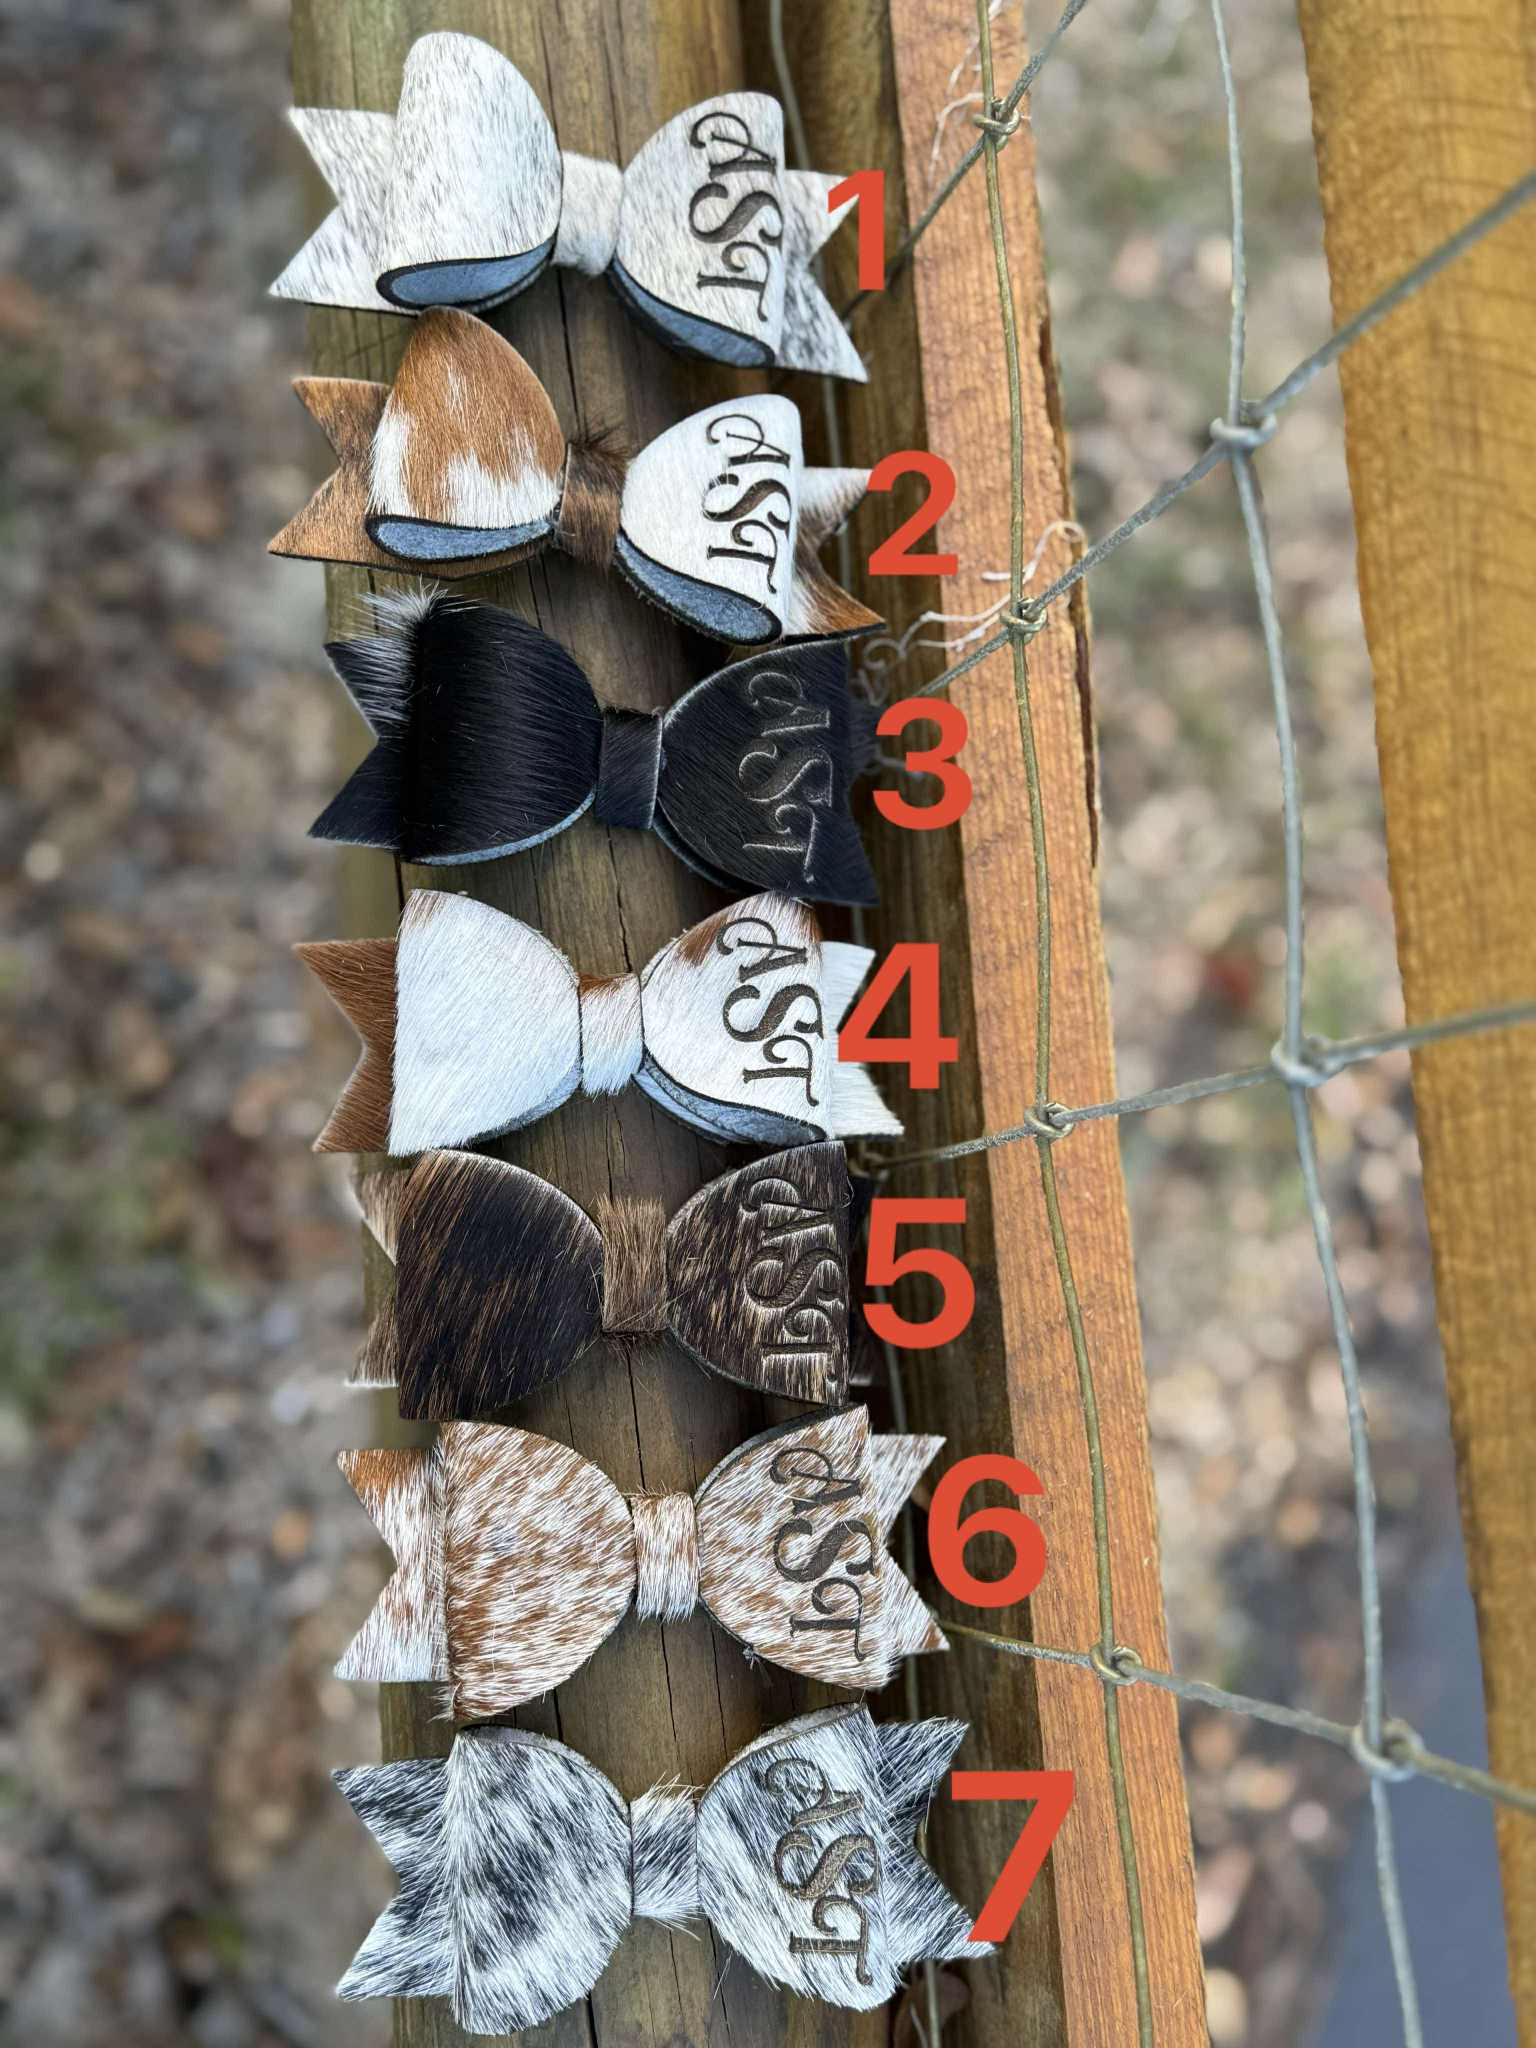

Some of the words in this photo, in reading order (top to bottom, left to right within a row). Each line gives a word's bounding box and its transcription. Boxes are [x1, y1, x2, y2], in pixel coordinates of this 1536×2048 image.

[689, 112, 784, 322] AST
[701, 413, 792, 594] AST
[739, 671, 832, 883] AST
[716, 917, 824, 1107] AST
[742, 1177, 845, 1383] AST
[769, 1447, 876, 1661] AST
[765, 1757, 880, 1985] AST
